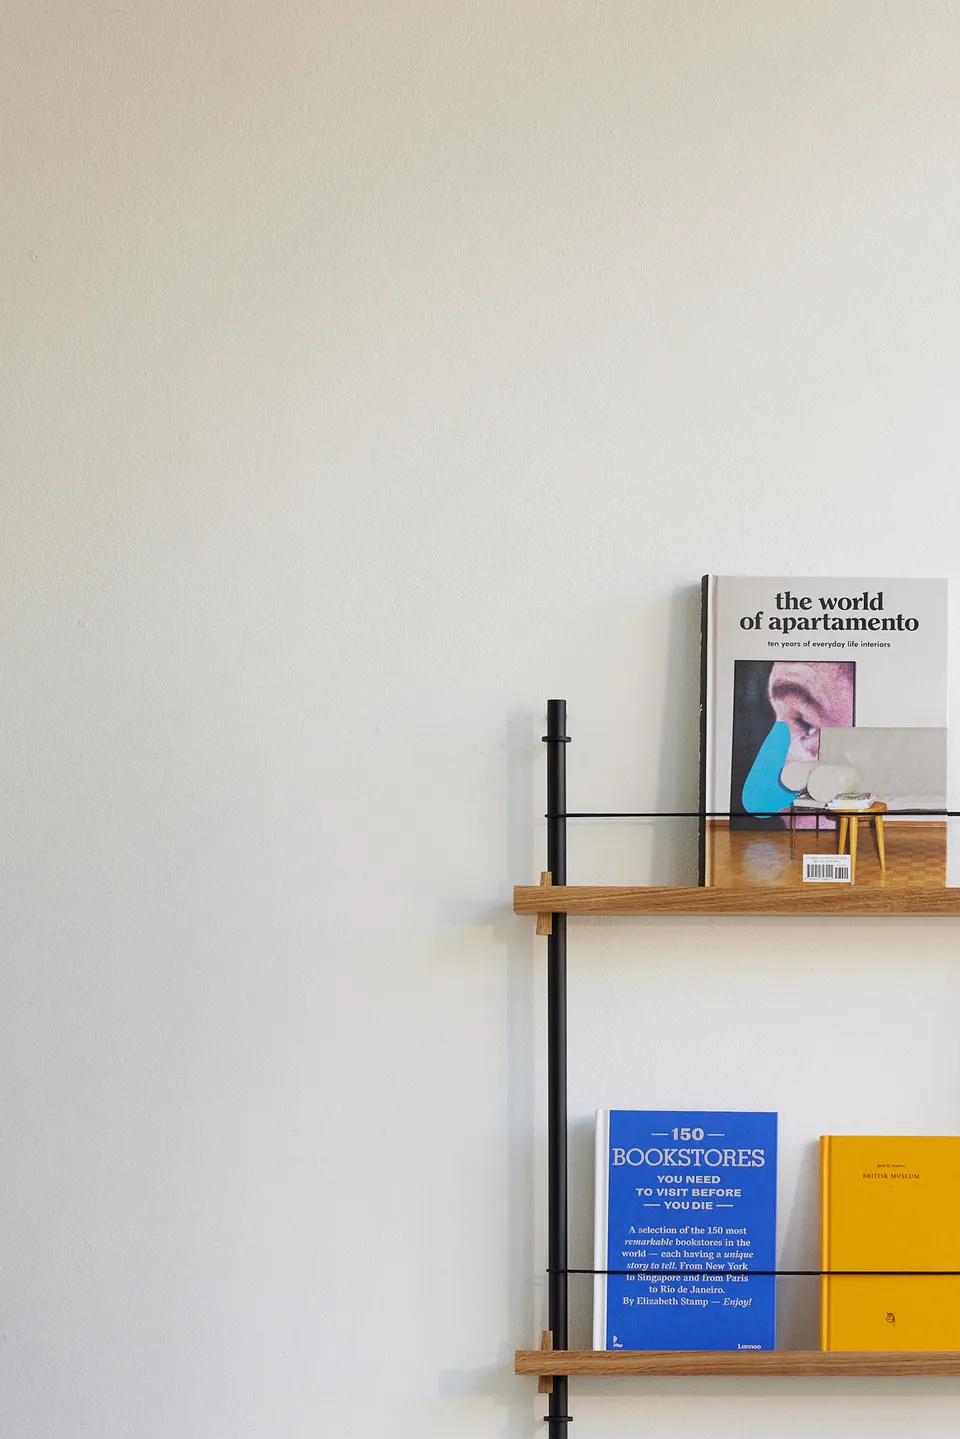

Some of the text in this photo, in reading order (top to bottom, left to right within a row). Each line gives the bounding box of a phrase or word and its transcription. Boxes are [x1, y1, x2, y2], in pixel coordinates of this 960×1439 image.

[774, 591, 884, 611] the world
[739, 611, 920, 634] of apartamento
[802, 640, 811, 648] of
[812, 641, 846, 649] everyday
[671, 1127, 705, 1141] 150
[612, 1148, 766, 1167] BOOKSTORES
[657, 1175, 721, 1184] YOU NEED
[635, 1188, 742, 1197] TO VISIT BEFORE
[663, 1201, 714, 1210] YOU DIE
[628, 1226, 747, 1235] A selection of the 150 most
[624, 1238, 751, 1247] remarkable bookstores in the
[622, 1249, 647, 1258] world
[660, 1250, 681, 1258] each
[683, 1250, 715, 1260] having
[723, 1251, 754, 1260] unique
[626, 1262, 748, 1271] story to tell. From New York
[626, 1273, 749, 1283] to Singapore and from Paris
[648, 1285, 726, 1294] to Rio de Janeiro.
[622, 1297, 635, 1306] By
[636, 1297, 678, 1305] Elizabeth
[680, 1297, 709, 1307] Stamp
[723, 1297, 752, 1308] Enjoy!
